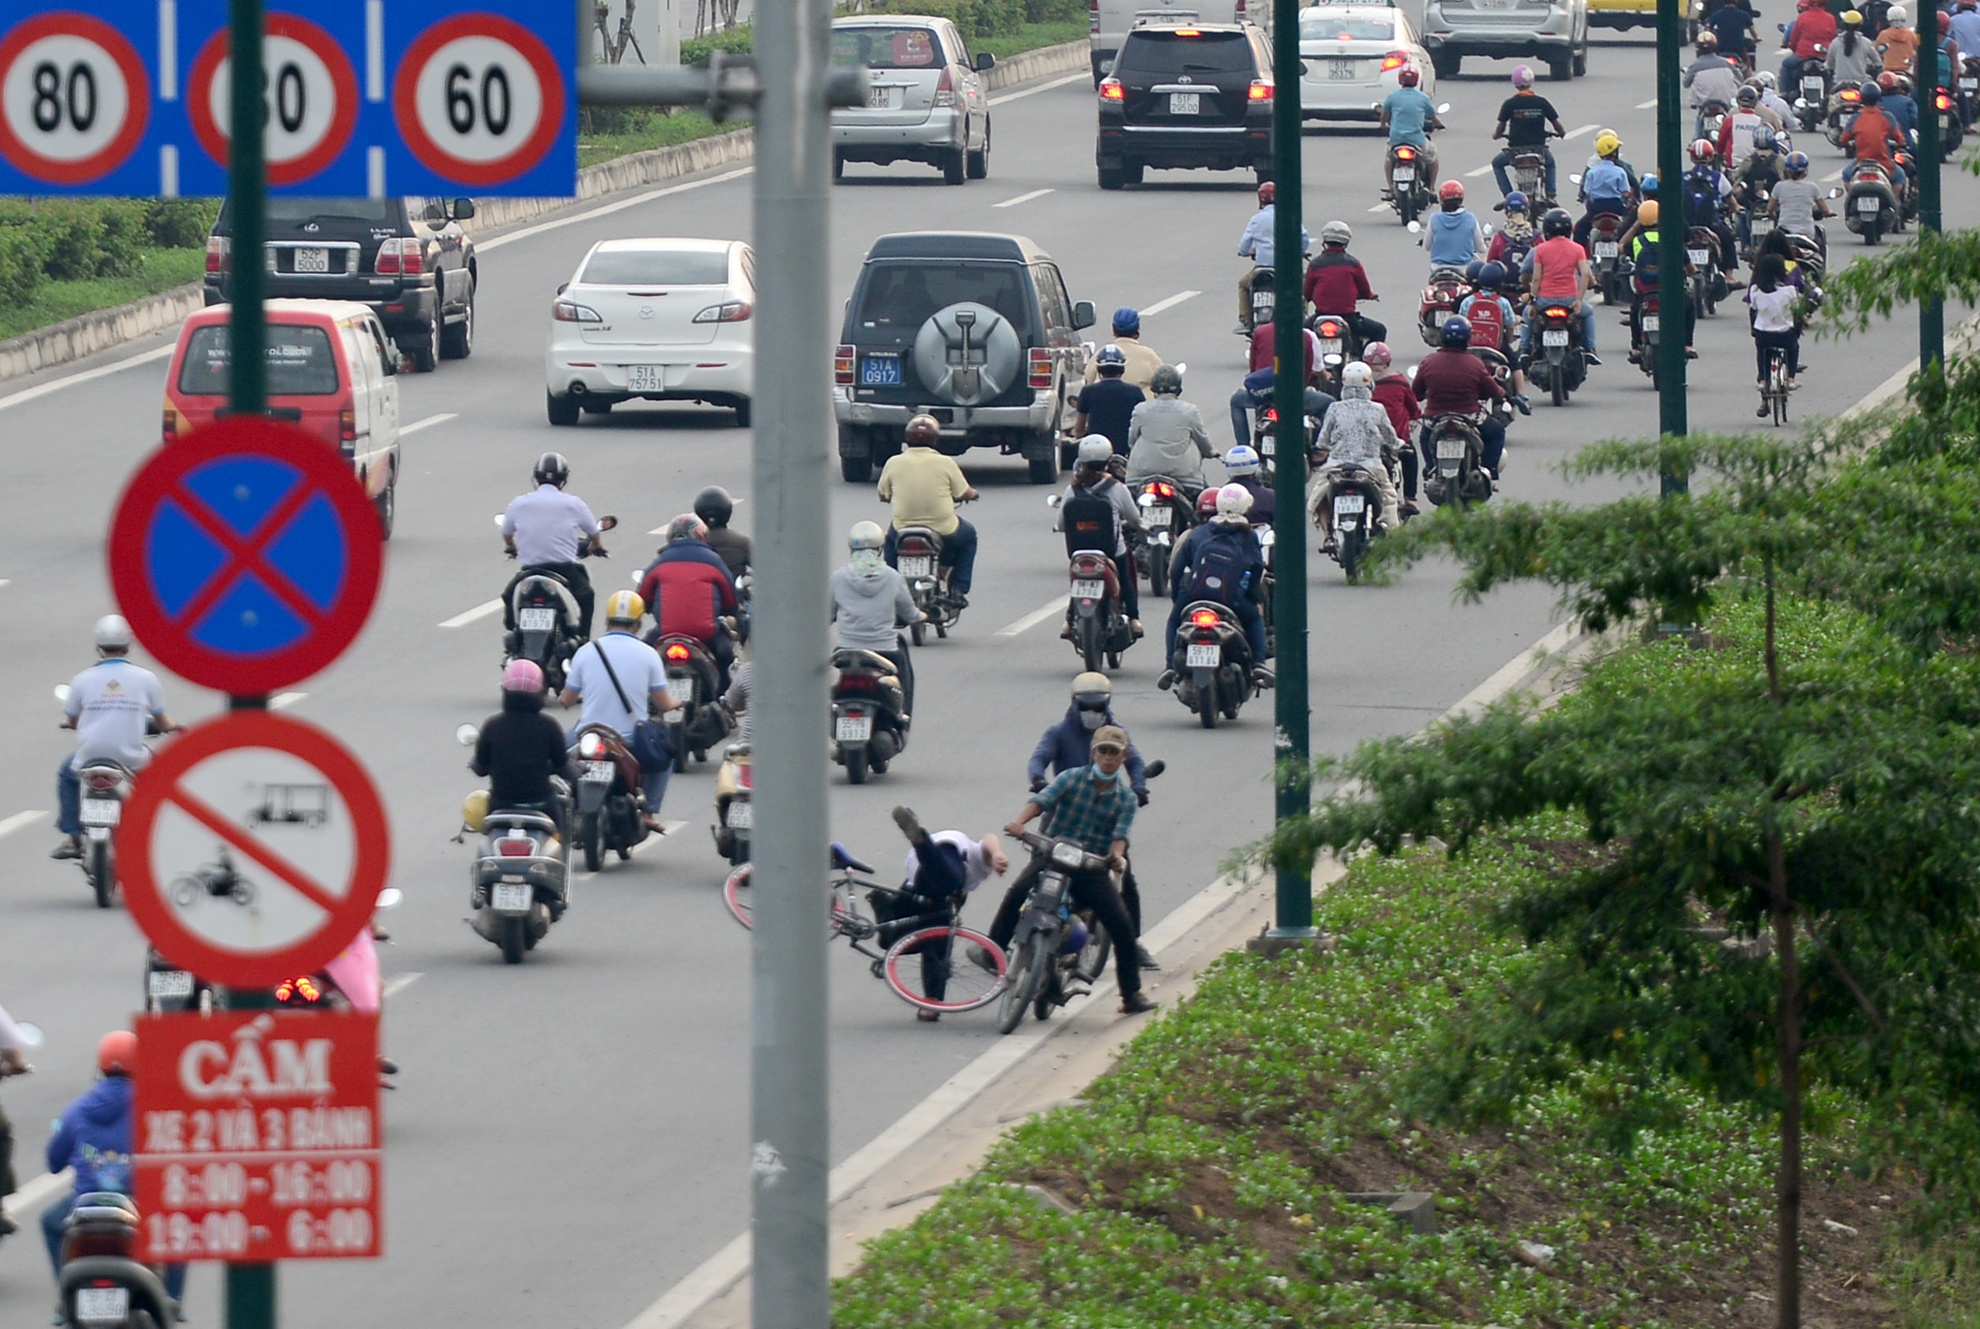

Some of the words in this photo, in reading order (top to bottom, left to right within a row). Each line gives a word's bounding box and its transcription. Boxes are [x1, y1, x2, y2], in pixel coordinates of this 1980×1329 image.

[32, 60, 97, 132] 80
[445, 63, 511, 136] 60
[298, 260, 325, 270] 5000
[637, 366, 655, 378] 51A
[866, 370, 896, 382] 0917
[870, 359, 892, 370] 51A
[179, 1013, 334, 1097] CẤM
[145, 1110, 185, 1151] XE
[190, 1109, 214, 1150] 2
[262, 1108, 286, 1148] 3
[287, 1207, 373, 1252] 6:00
